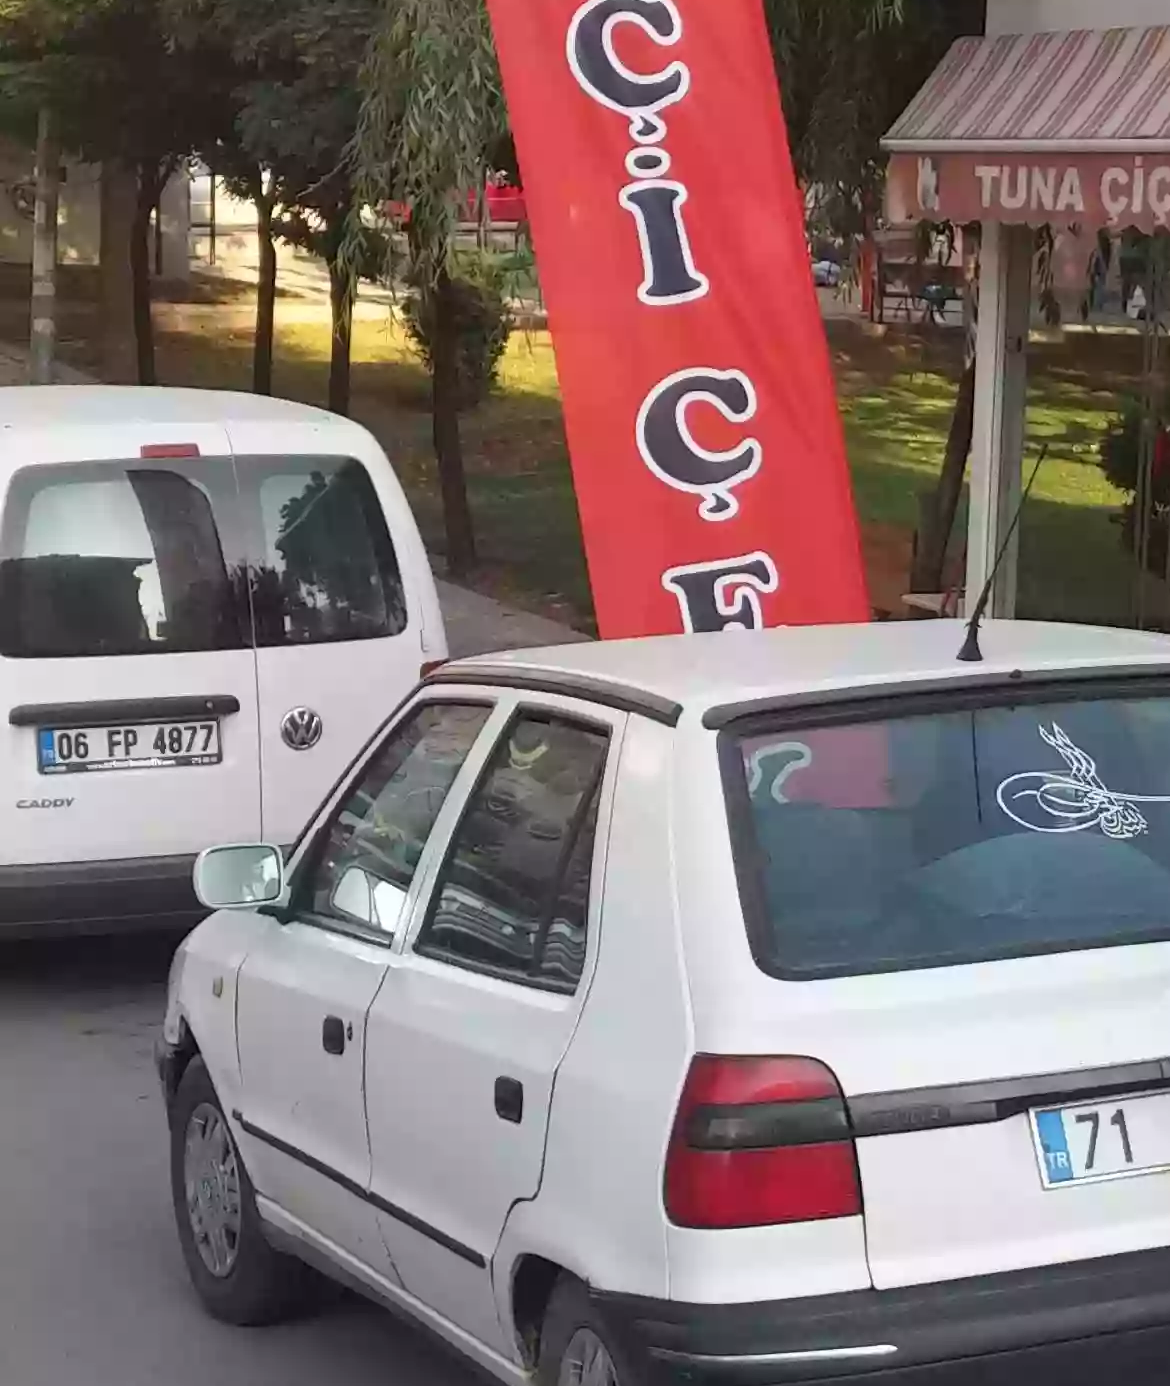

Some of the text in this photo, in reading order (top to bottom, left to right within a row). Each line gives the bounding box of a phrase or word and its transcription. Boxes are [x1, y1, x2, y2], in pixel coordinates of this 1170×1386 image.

[974, 164, 1086, 213] TUNA
[57, 731, 89, 761] 06
[107, 729, 139, 758] FP
[152, 724, 215, 756] 4877
[16, 796, 75, 810] CADDY
[1047, 1150, 1069, 1170] TR
[1075, 1108, 1134, 1171] 71
